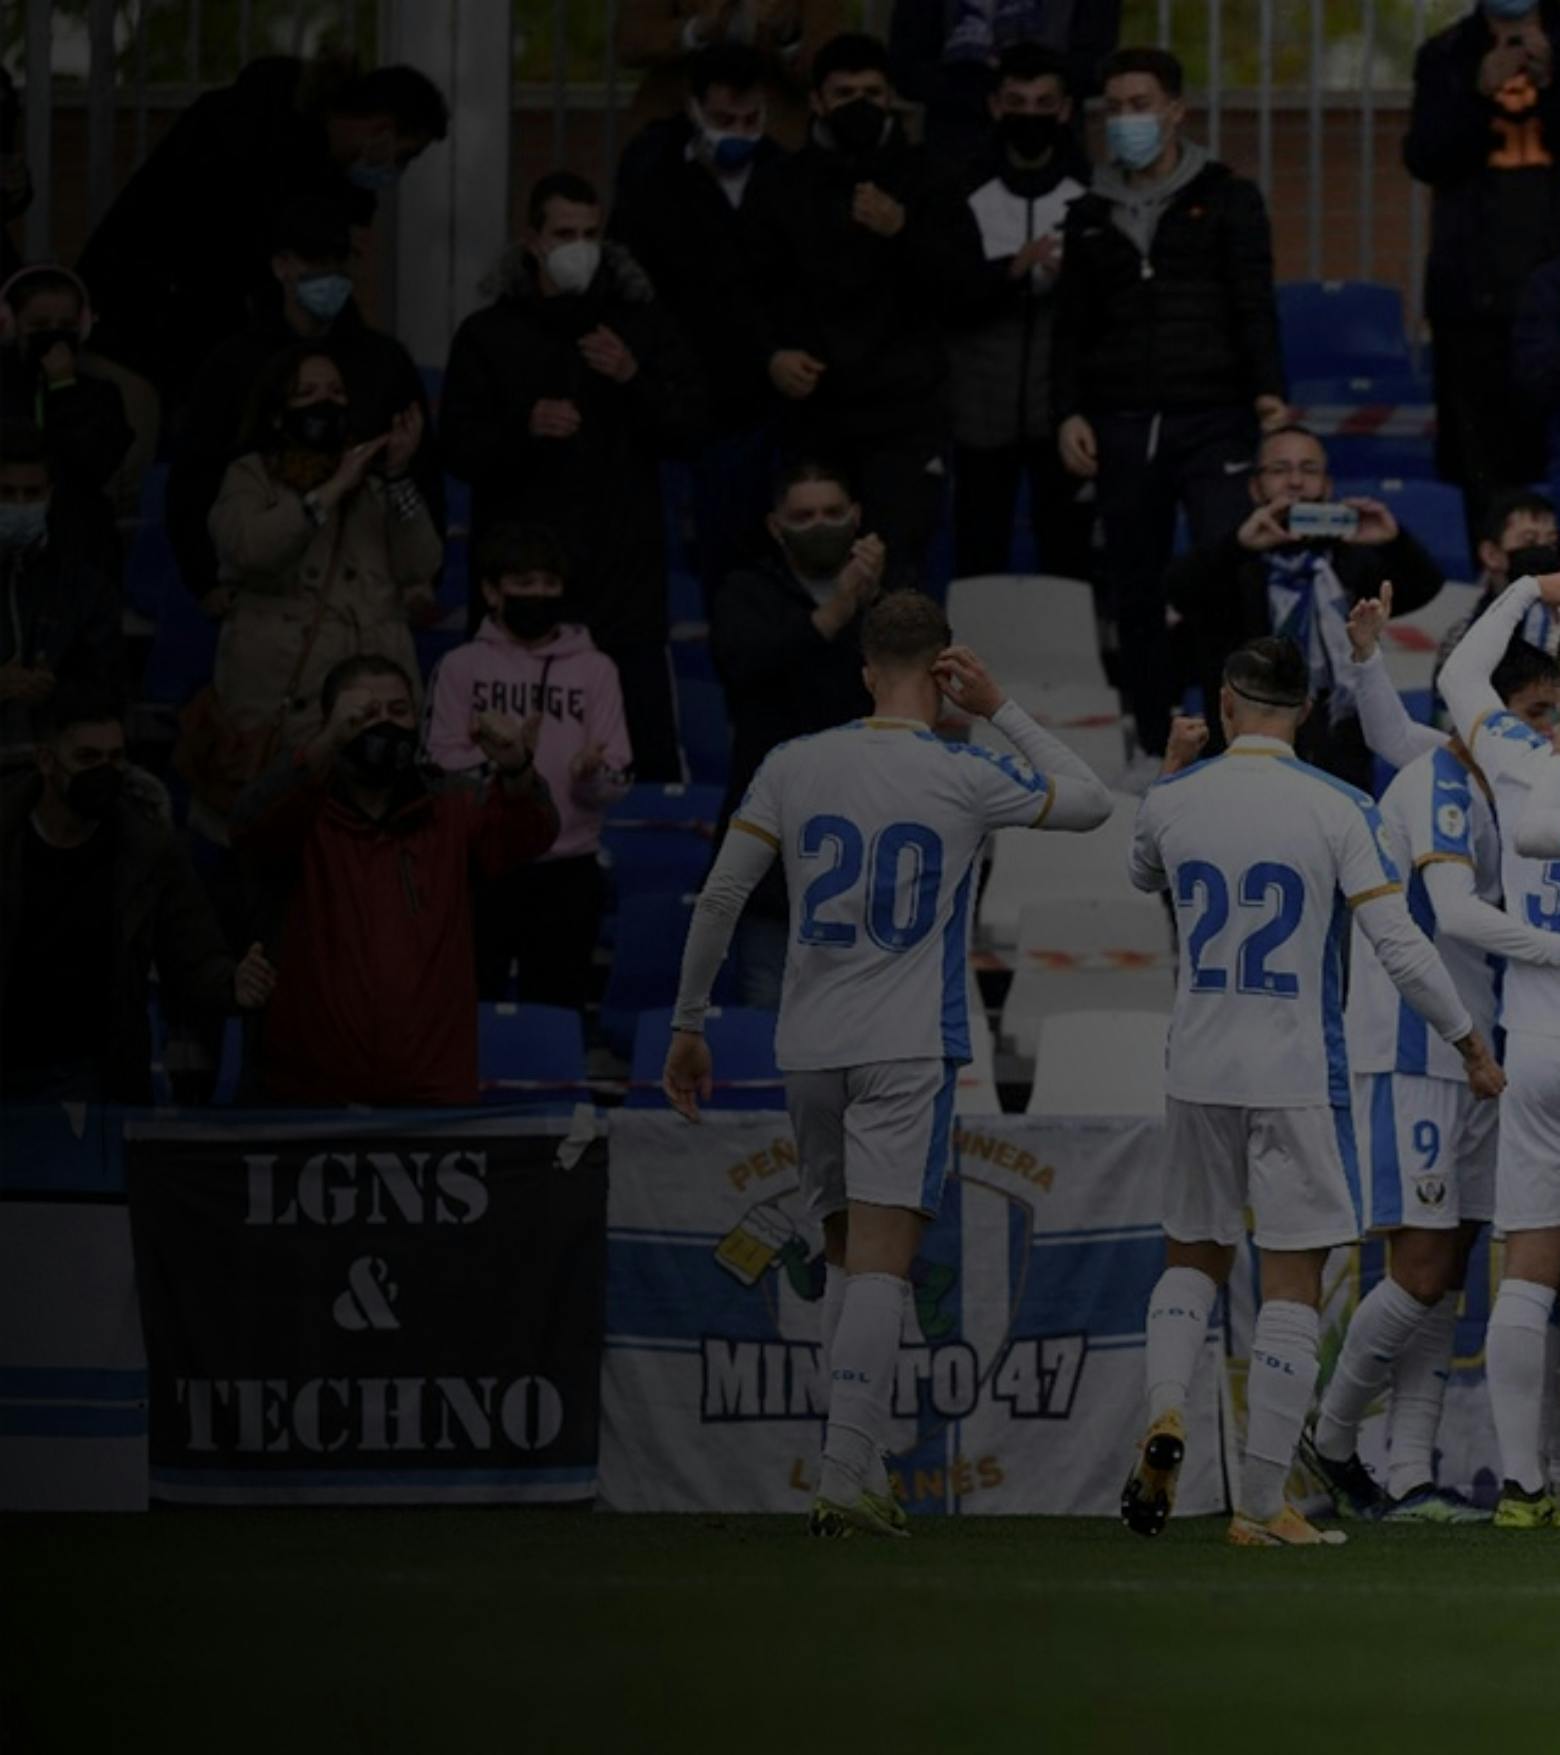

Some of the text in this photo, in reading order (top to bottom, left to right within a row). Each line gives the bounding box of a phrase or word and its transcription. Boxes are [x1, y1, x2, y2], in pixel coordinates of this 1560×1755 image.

[799, 813, 943, 953] 20
[1176, 861, 1301, 998] 22
[726, 1136, 798, 1192] PEÑ
[1413, 1120, 1440, 1170] 9
[242, 1151, 489, 1226] LGNS
[332, 1254, 400, 1331] &
[176, 1375, 565, 1452] TECHNO
[702, 1330, 1088, 1421] MINTO 47
[831, 1367, 871, 1384] CDL
